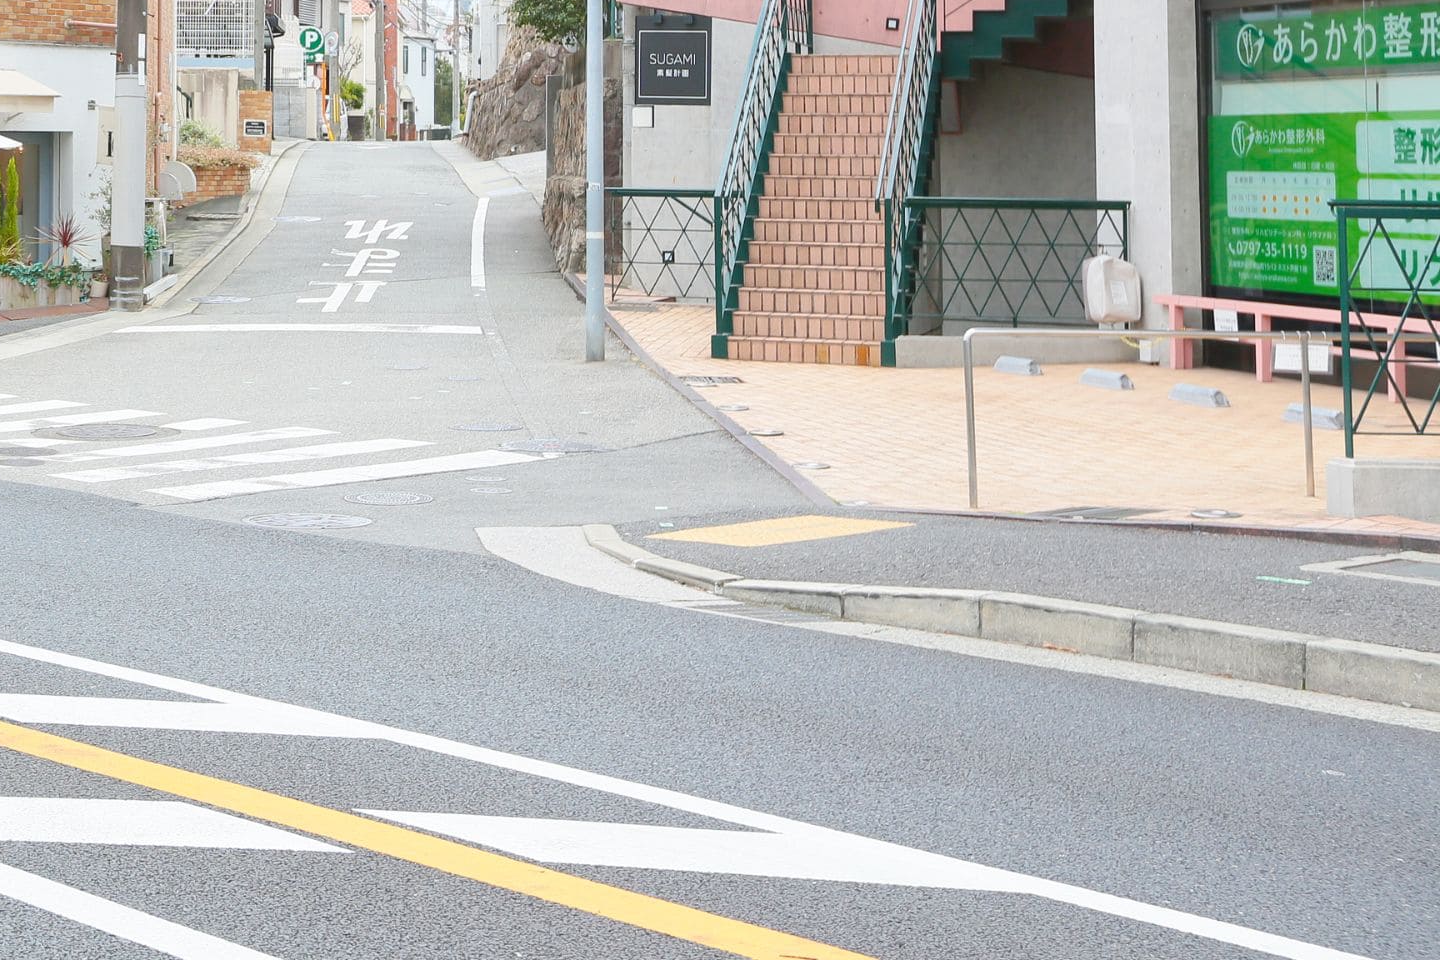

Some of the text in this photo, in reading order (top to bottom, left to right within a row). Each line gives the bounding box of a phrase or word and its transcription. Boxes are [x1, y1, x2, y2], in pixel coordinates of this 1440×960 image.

[305, 31, 319, 48] P
[1273, 12, 1440, 65] あらかわ整形
[649, 53, 696, 65] SUGAMI
[1254, 128, 1325, 145] あらかわ整形外科
[1393, 127, 1440, 165] 整形
